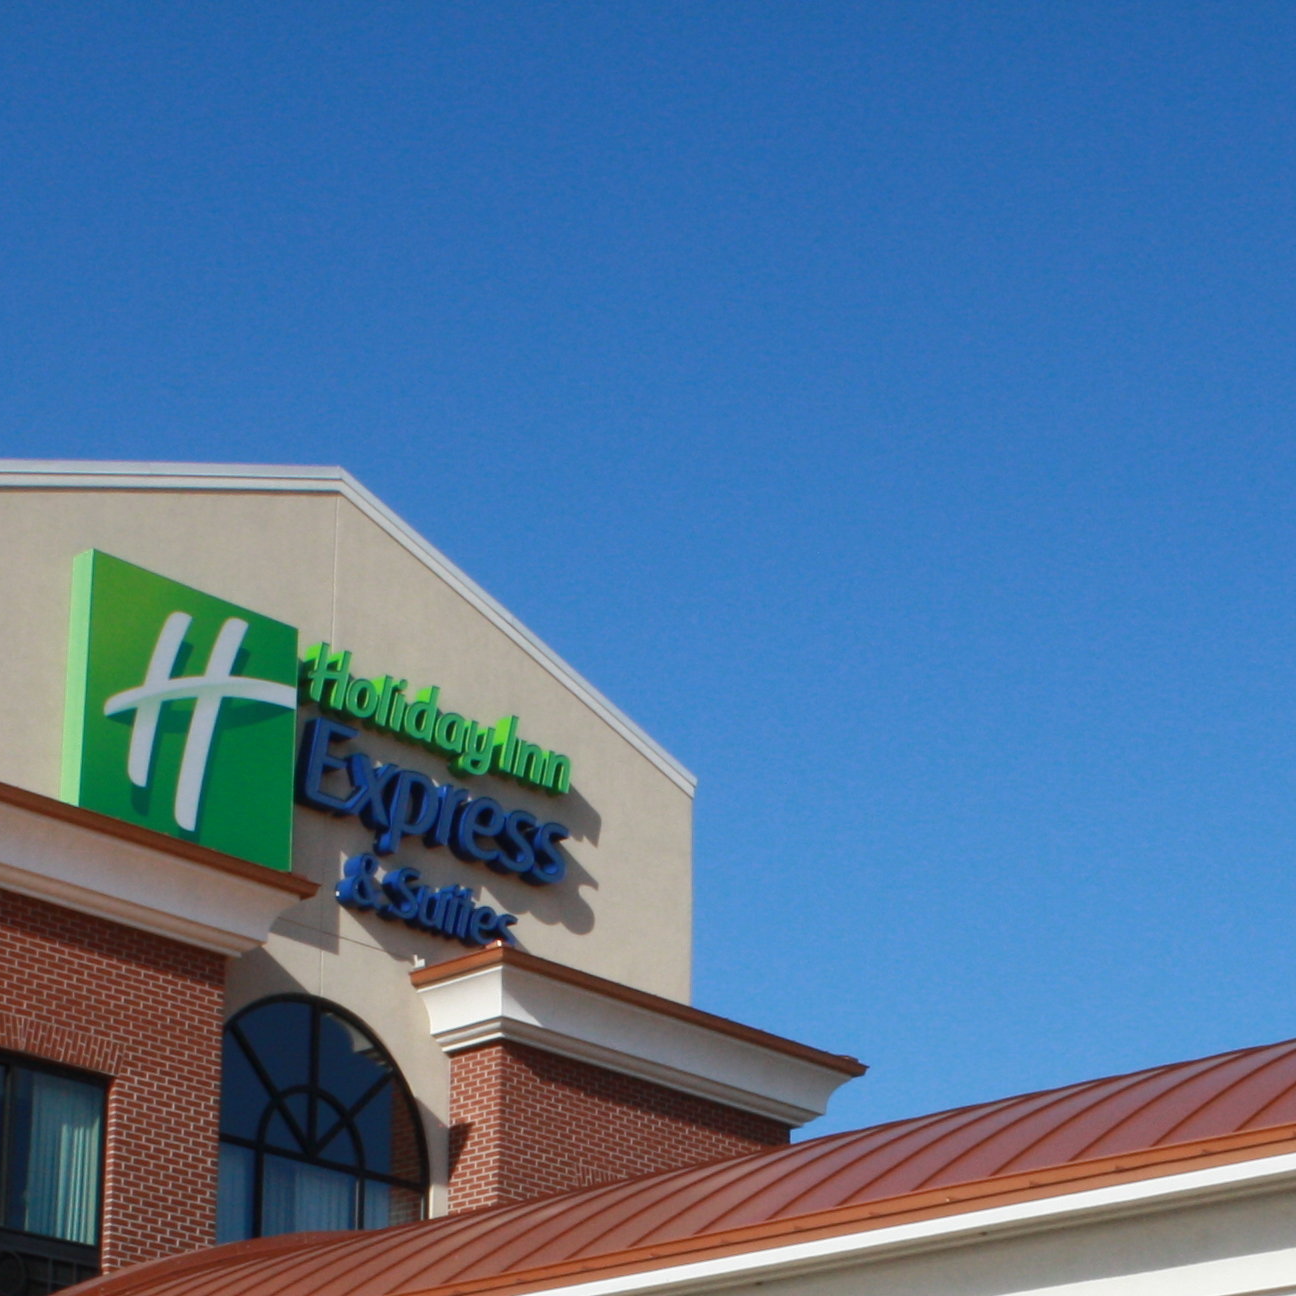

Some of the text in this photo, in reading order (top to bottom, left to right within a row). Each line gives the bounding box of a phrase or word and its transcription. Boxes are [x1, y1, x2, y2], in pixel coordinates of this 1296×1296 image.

[305, 641, 571, 794] Holiday Inn
[302, 716, 572, 885] Express
[335, 852, 518, 945] & Suites
